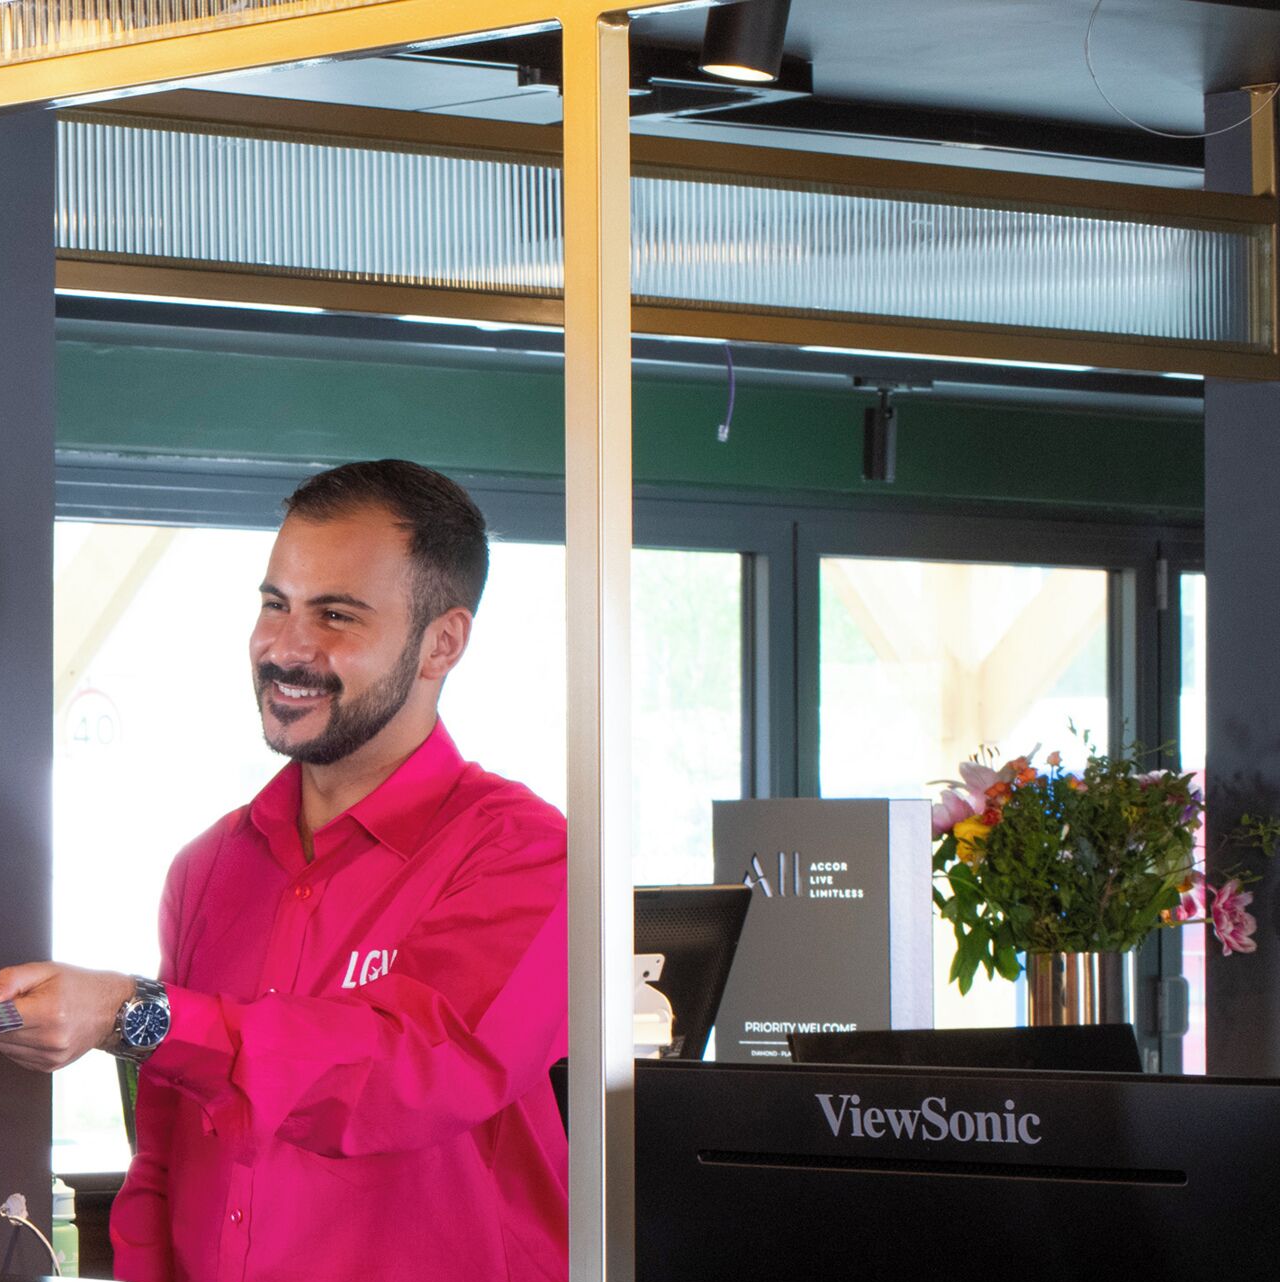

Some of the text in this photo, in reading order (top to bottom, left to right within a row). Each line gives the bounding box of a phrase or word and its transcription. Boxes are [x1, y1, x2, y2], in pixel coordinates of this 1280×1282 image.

[810, 862, 848, 872] ACCOR
[810, 876, 834, 885] LIVE
[810, 889, 864, 899] LIMITLESS
[745, 1022, 857, 1033] PRIORITY WELCOME
[815, 1094, 1042, 1145] ViewSonic
